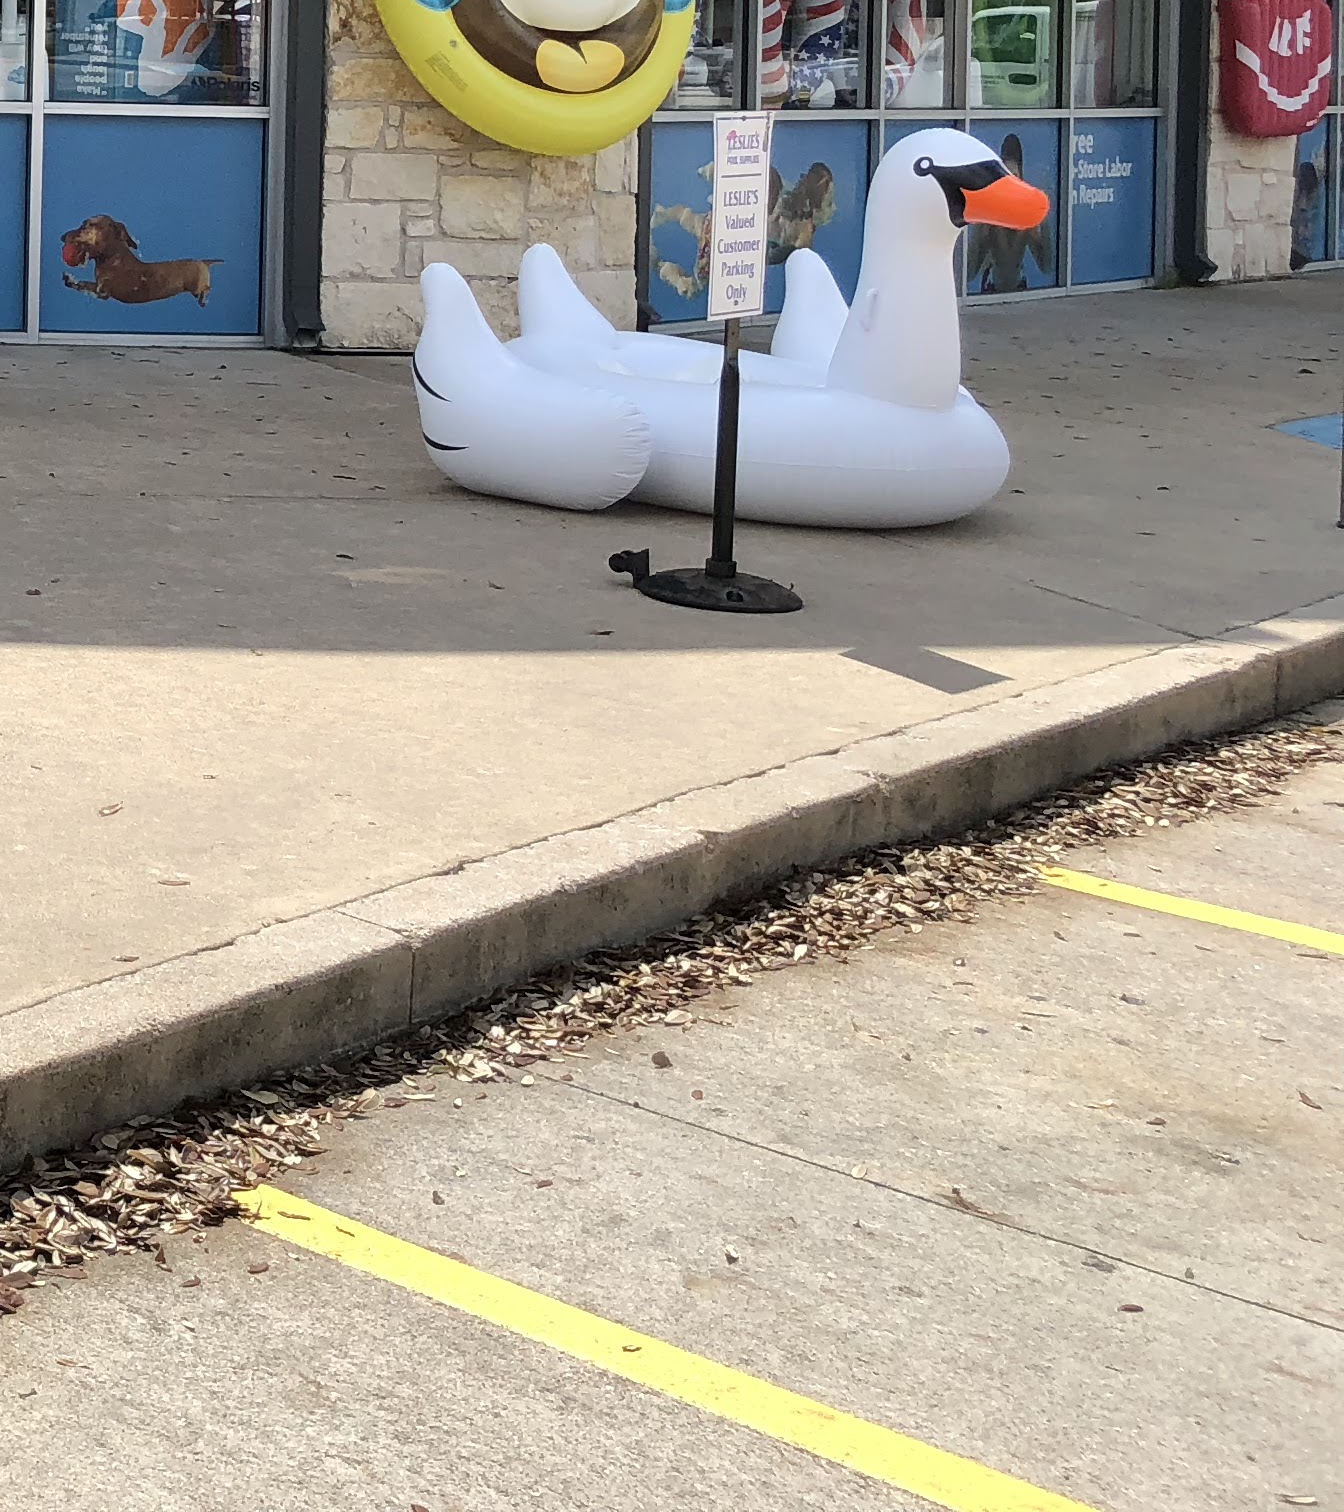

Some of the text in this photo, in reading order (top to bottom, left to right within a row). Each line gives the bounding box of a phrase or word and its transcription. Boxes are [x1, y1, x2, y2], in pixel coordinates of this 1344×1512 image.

[1071, 134, 1094, 154] ree
[1105, 155, 1132, 178] Labor
[723, 189, 759, 207] LESLIE'S
[1079, 184, 1114, 210] Repairs
[724, 213, 756, 231] Valued
[717, 238, 761, 255] Customer
[721, 260, 755, 279] Parking
[725, 283, 748, 303] Only
